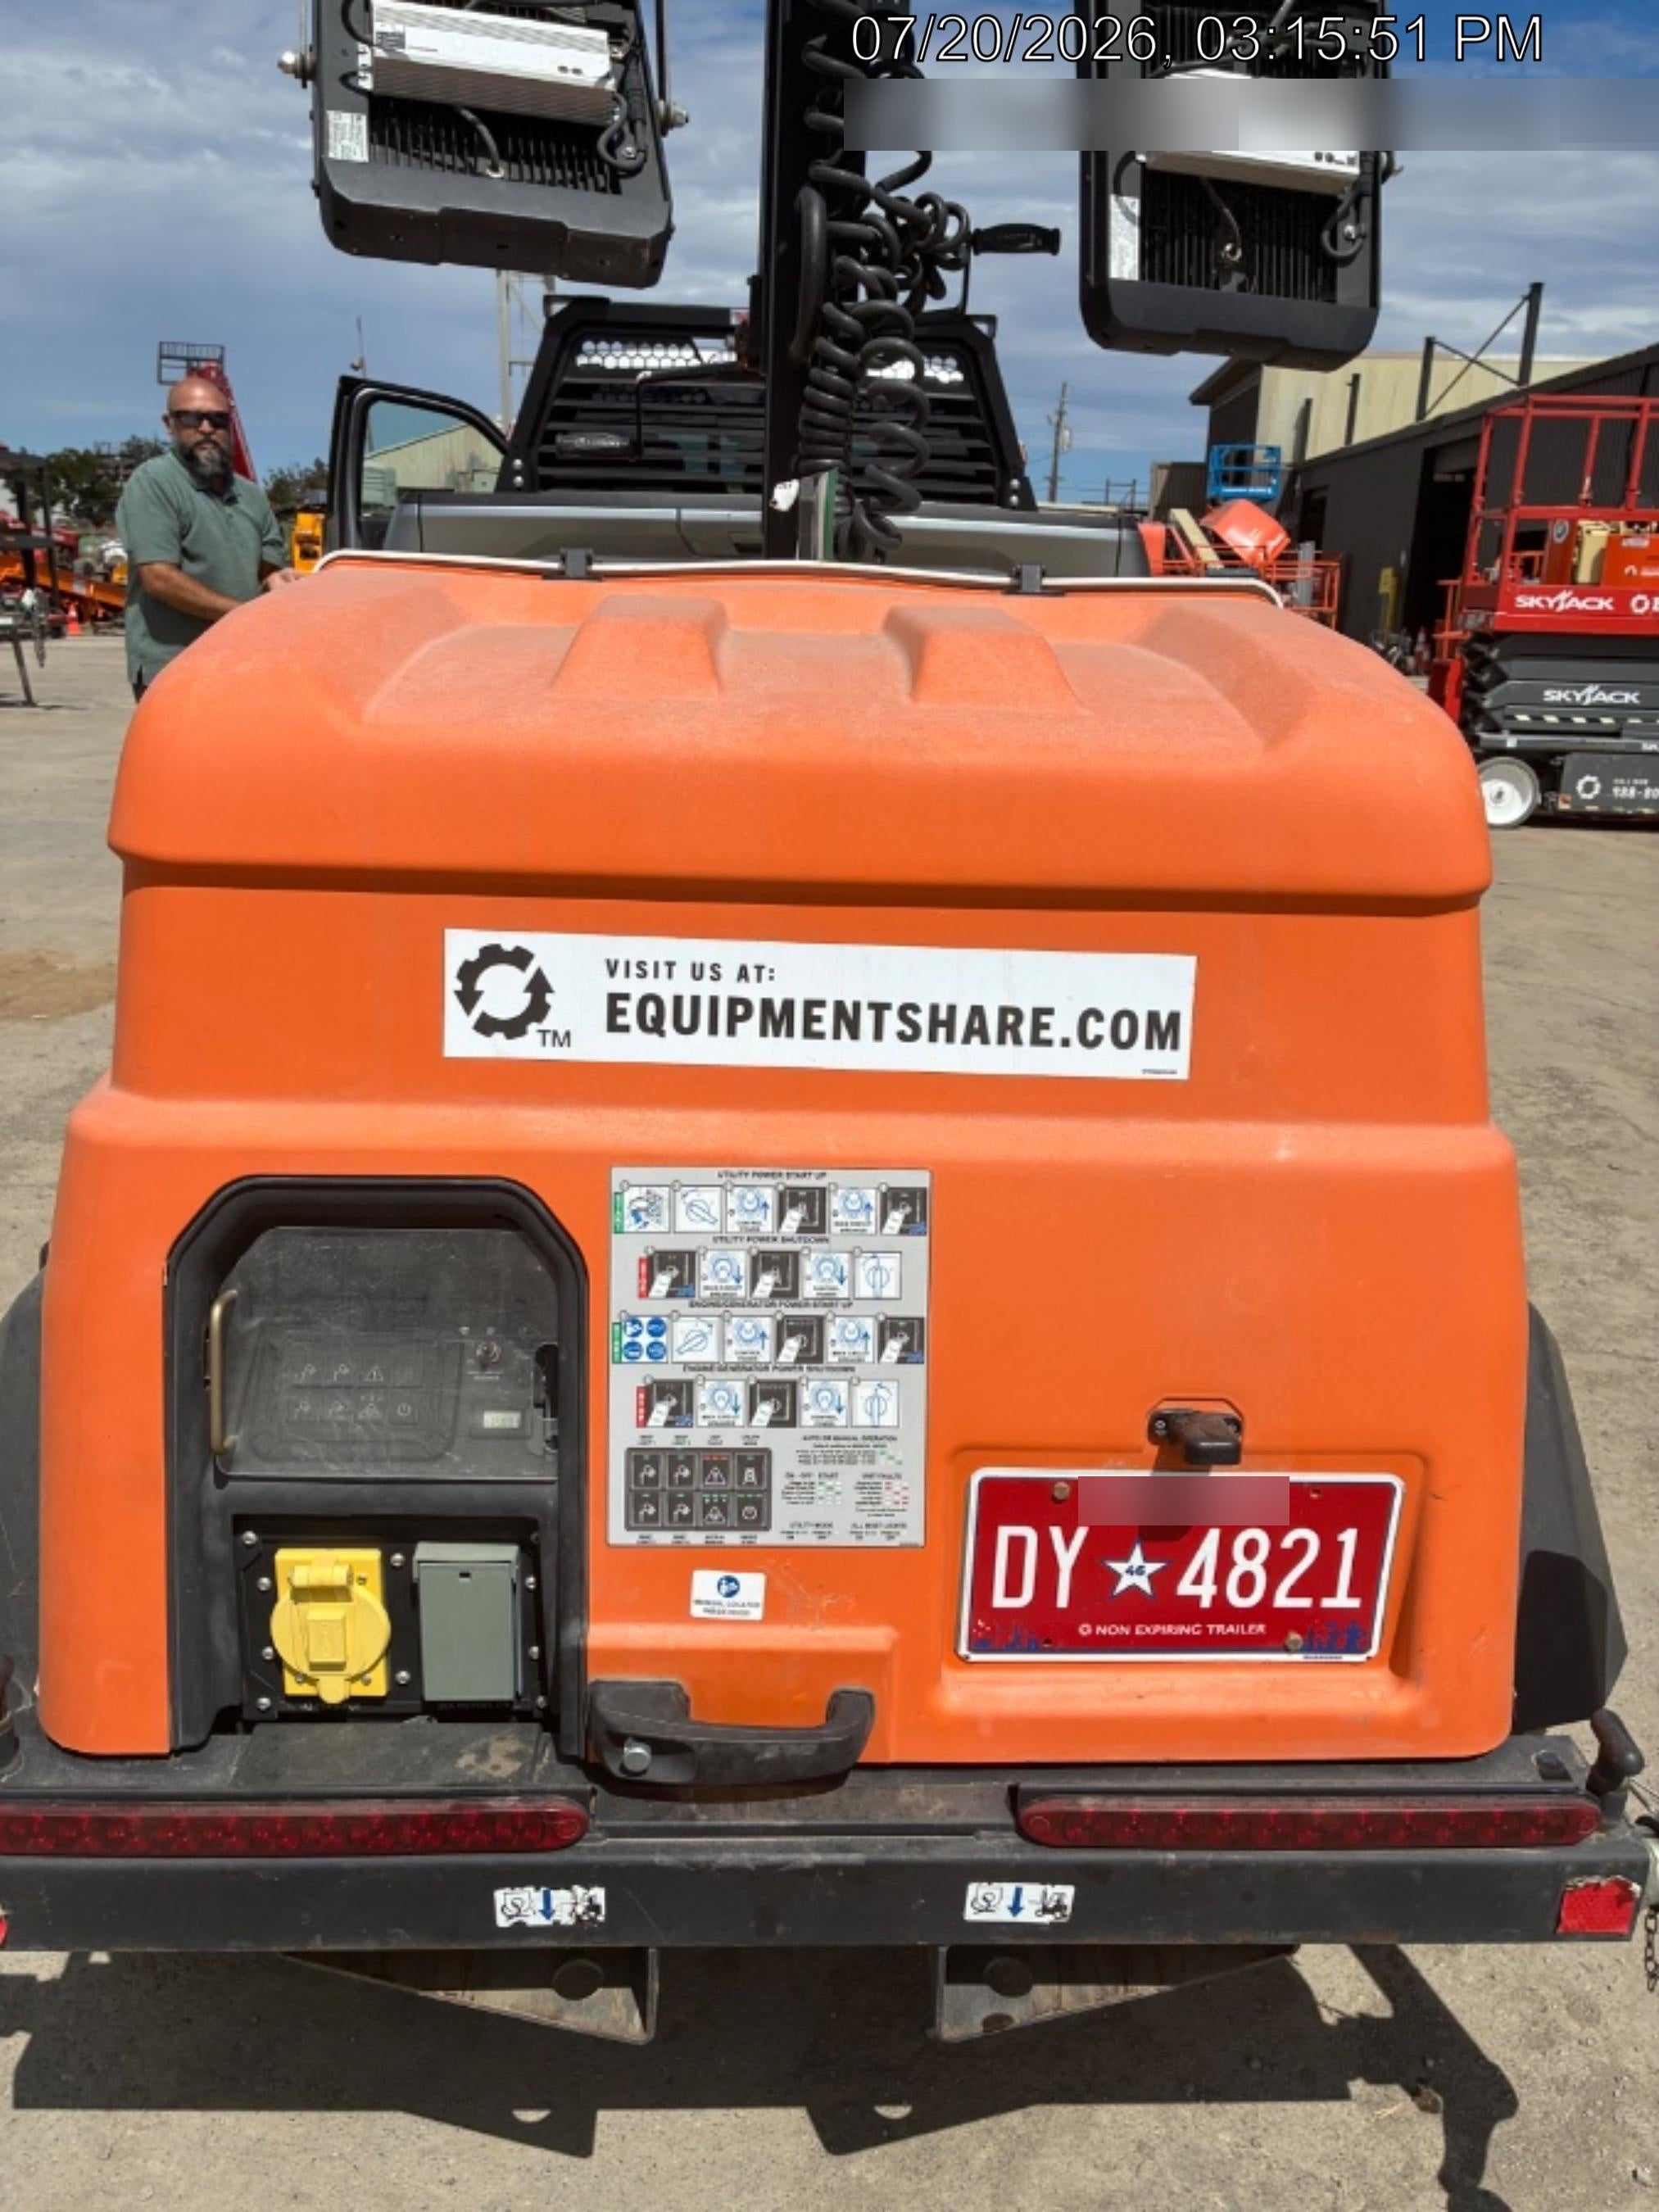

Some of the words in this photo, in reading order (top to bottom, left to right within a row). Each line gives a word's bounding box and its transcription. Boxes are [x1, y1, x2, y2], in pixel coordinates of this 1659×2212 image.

[1516, 590, 1614, 612] SKYJACK
[1543, 684, 1641, 705] SKYJACK
[605, 958, 677, 980] VISIT
[691, 961, 723, 981] US
[737, 963, 775, 984] AT:
[605, 991, 1181, 1052] EQUIPMENTSHARE.COM
[537, 1028, 571, 1048] TM
[991, 1525, 1090, 1609] DY
[1176, 1526, 1362, 1610] 4821
[1126, 1565, 1146, 1576] 46
[1095, 1624, 1131, 1636] NON
[1135, 1624, 1203, 1636] EXPIRING
[1207, 1623, 1267, 1635] TRAILER
